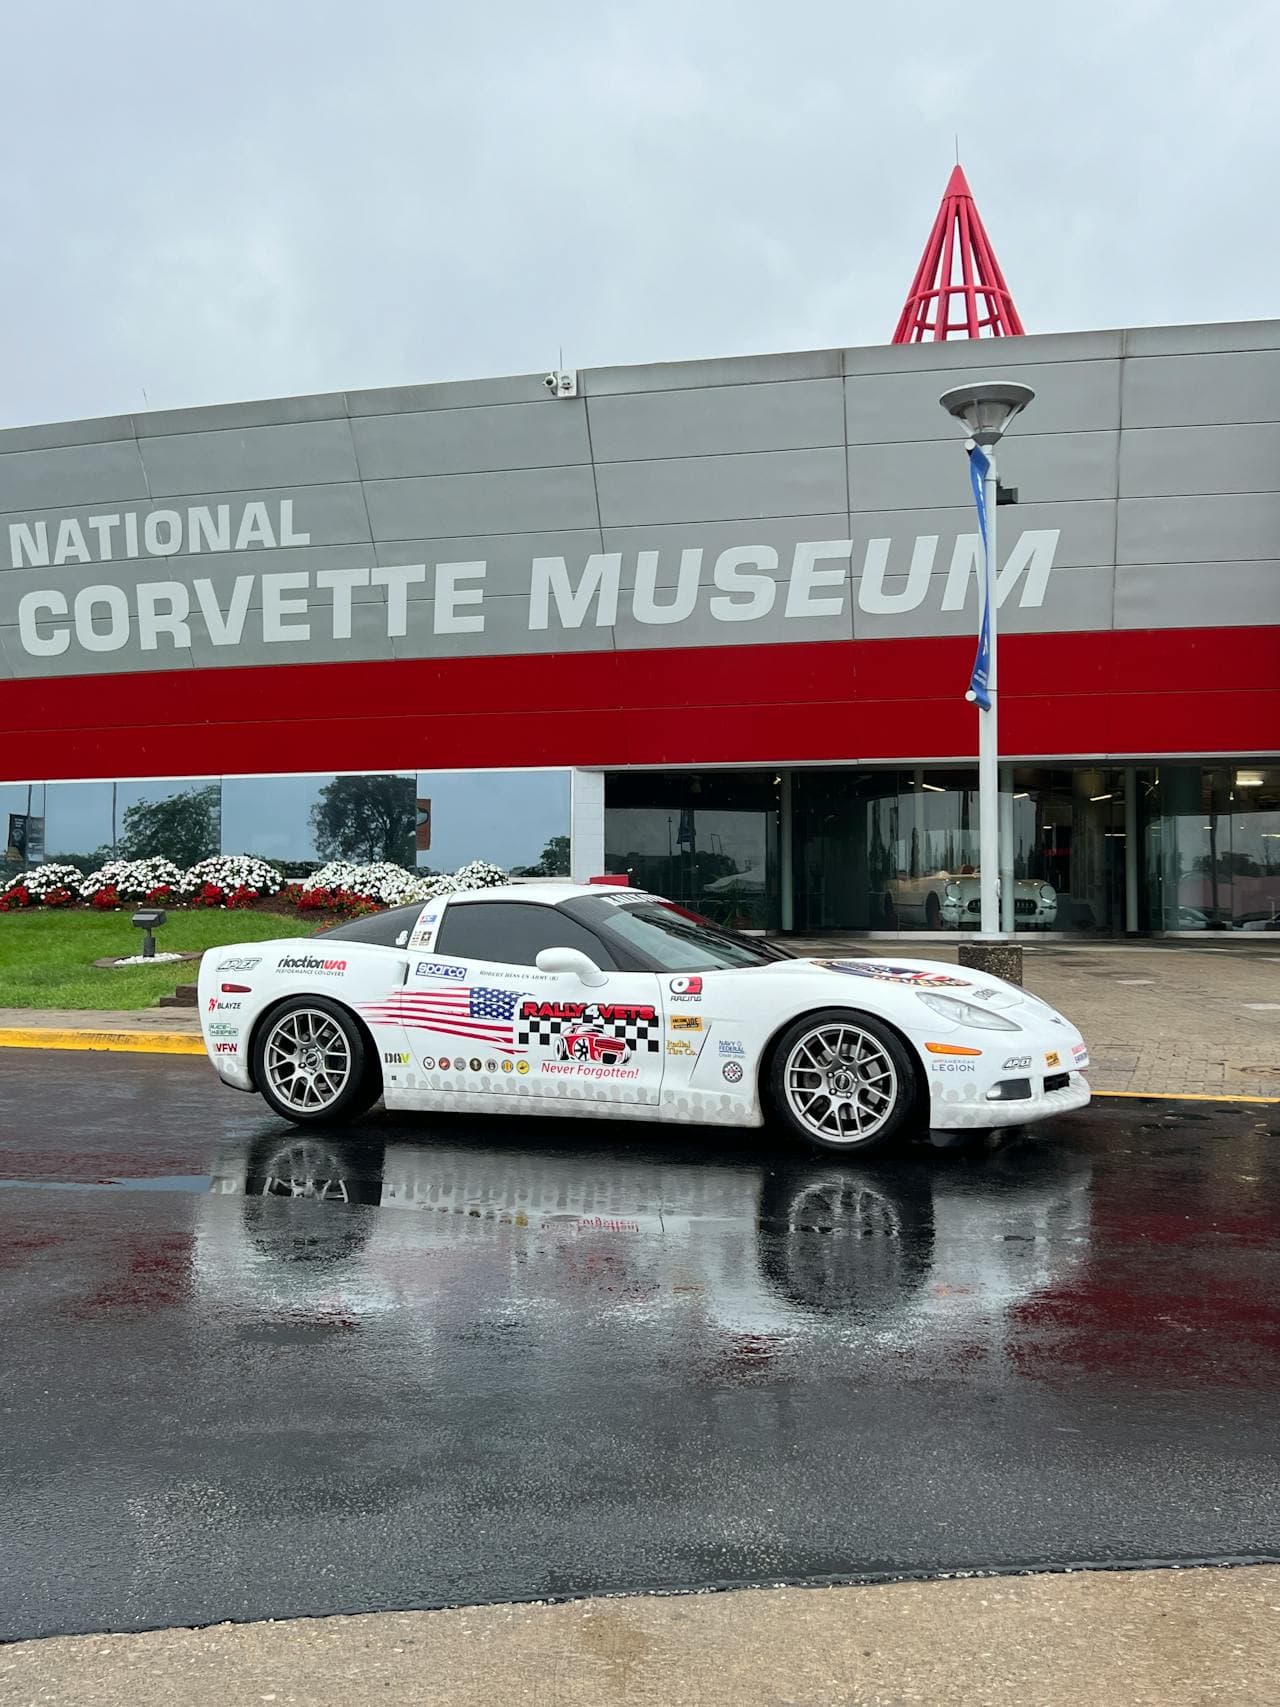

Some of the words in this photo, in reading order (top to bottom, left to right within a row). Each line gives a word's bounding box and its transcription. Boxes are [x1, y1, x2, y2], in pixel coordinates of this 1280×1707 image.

[9, 499, 311, 568] NATIONAL
[18, 560, 487, 657] CORVETTE
[528, 529, 1061, 630] MUSEUM
[417, 962, 466, 979] sparco
[217, 1002, 241, 1010] BLAYZE
[522, 1001, 655, 1020] RALLY4VETS
[215, 1043, 238, 1053] VFW
[541, 1062, 574, 1075] Never
[577, 1064, 639, 1079] Forgotten!
[931, 1064, 975, 1072] LEGION
